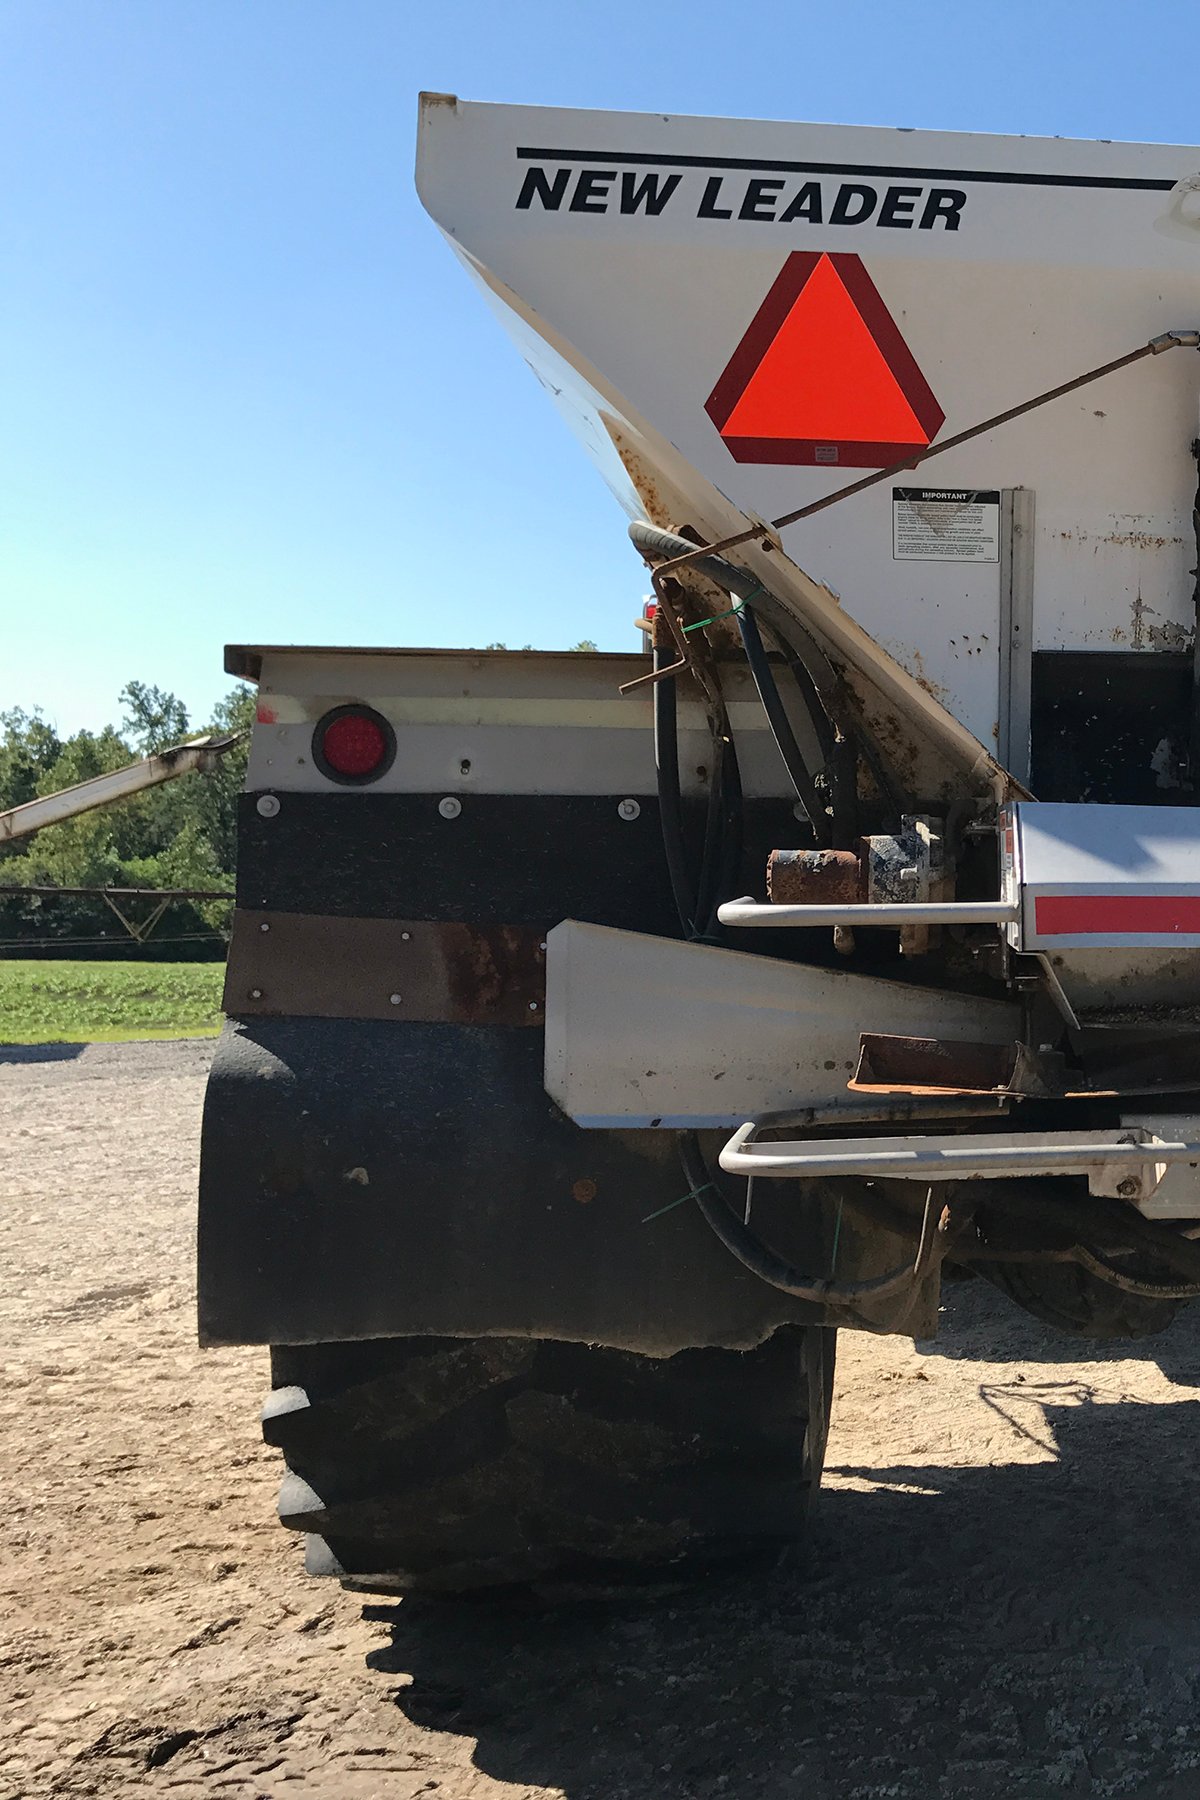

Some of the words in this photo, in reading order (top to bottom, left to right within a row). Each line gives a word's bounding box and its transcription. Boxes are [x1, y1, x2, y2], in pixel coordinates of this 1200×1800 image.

[515, 167, 683, 216] NEW
[696, 176, 967, 231] LEADER
[922, 492, 968, 500] IMPORTANT
